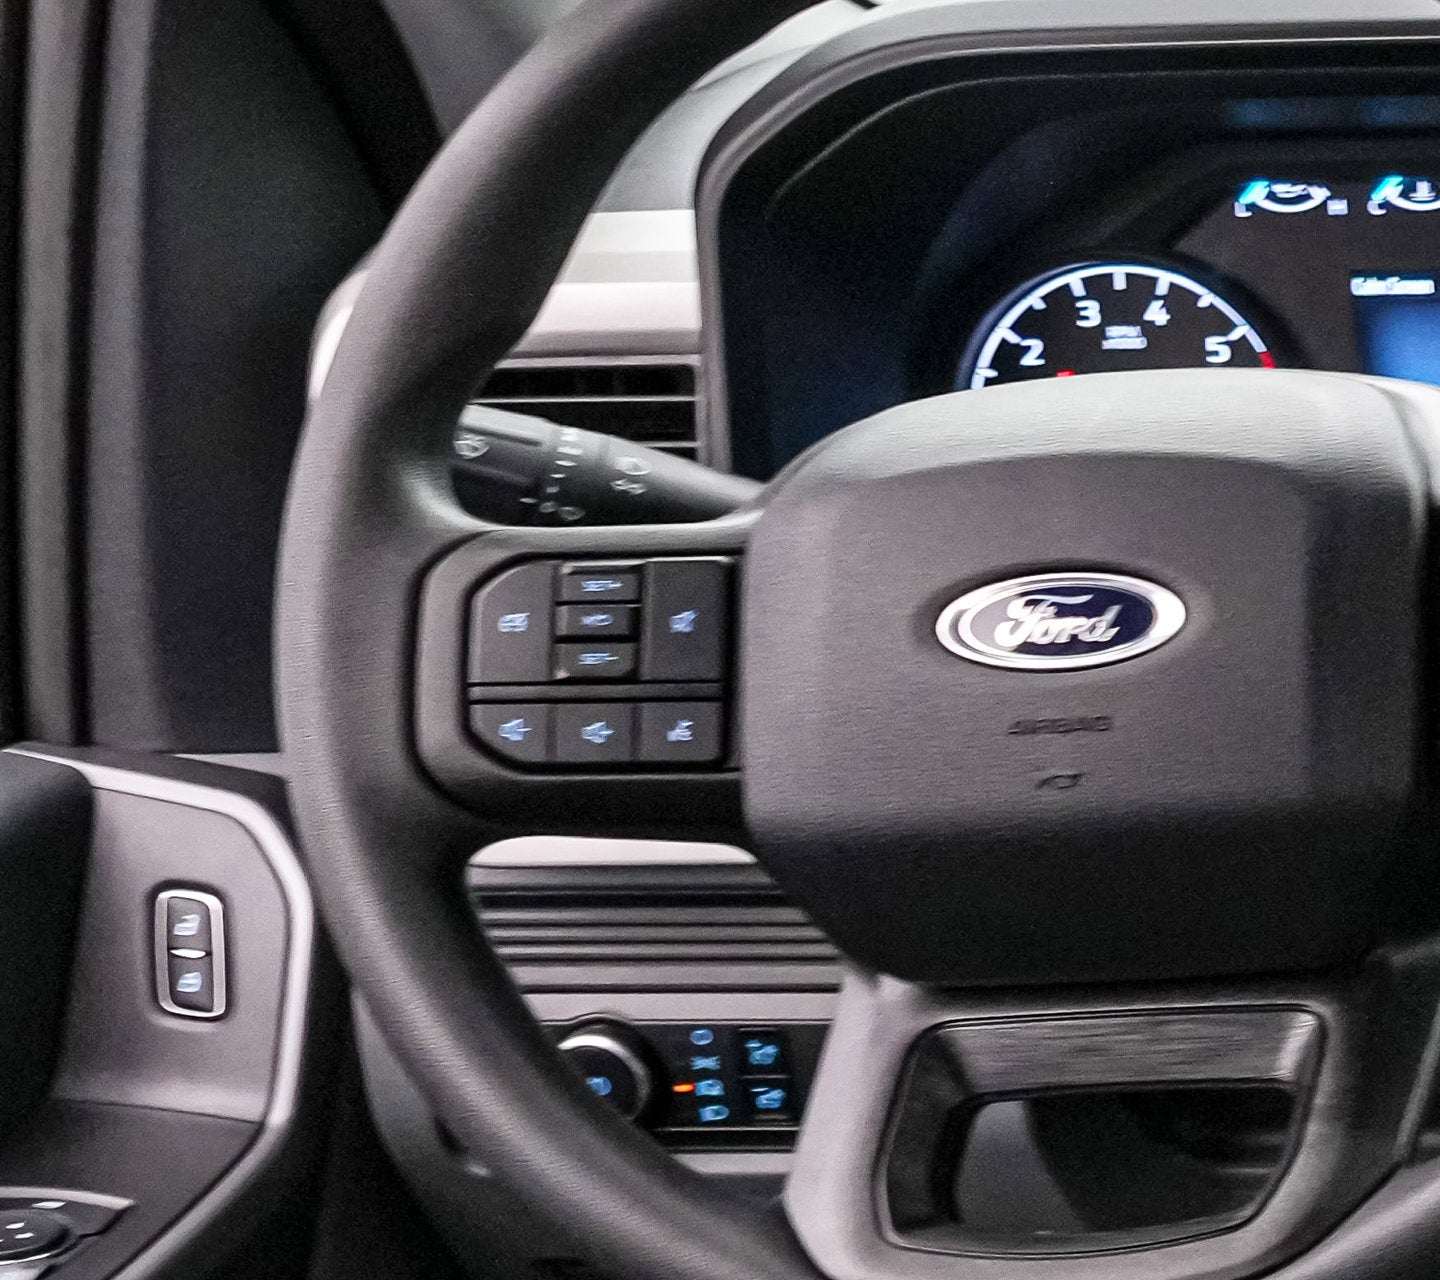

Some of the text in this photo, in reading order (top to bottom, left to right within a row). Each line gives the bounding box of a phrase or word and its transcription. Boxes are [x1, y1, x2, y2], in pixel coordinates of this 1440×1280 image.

[1074, 299, 1102, 328] 3
[1142, 299, 1172, 327] 4
[1018, 337, 1047, 367] 2
[1203, 334, 1233, 364] 5
[994, 593, 1124, 651] Ford
